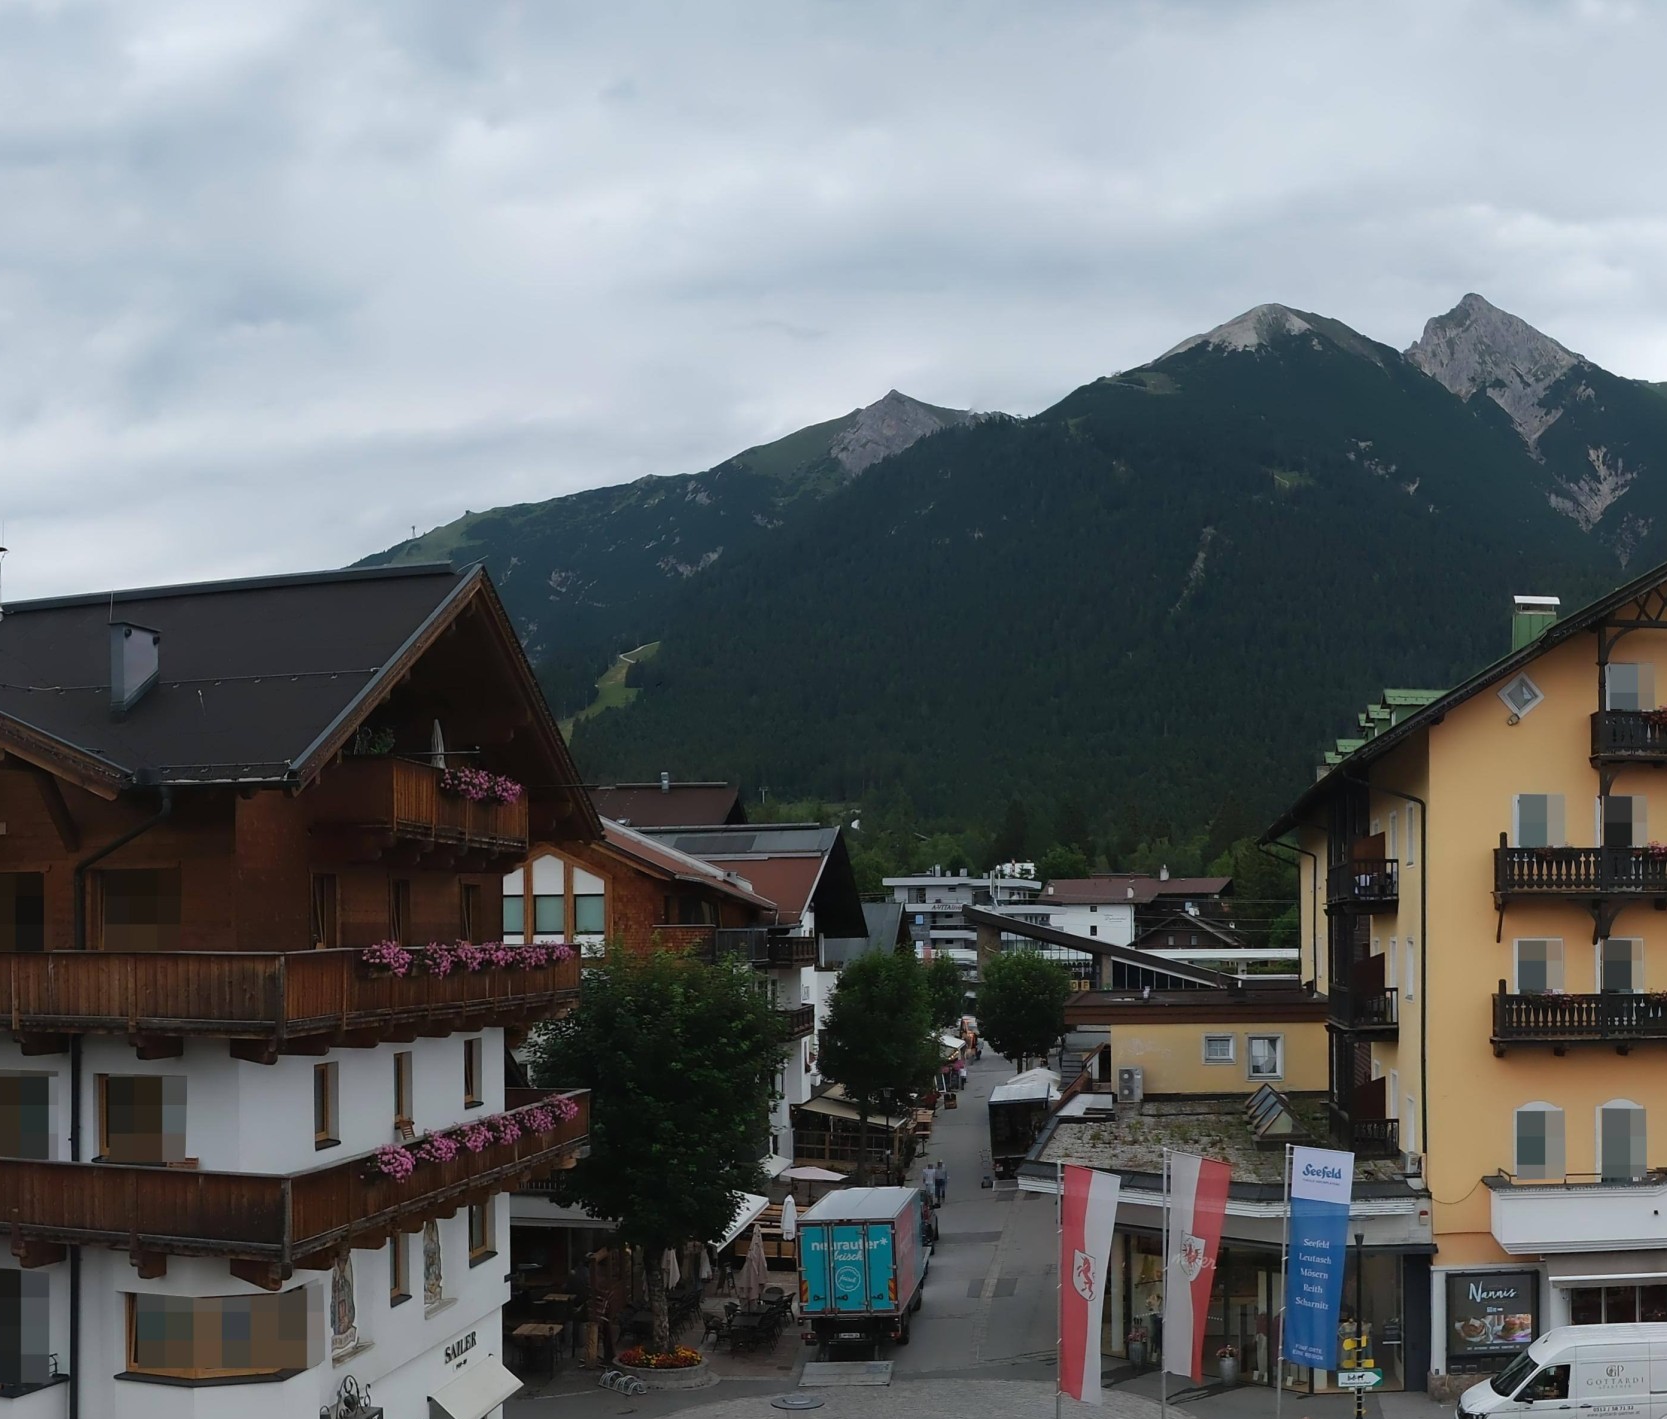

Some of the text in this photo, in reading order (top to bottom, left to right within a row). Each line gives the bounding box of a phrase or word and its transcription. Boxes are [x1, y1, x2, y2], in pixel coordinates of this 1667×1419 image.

[1302, 1163, 1342, 1179] Seefeld
[1303, 1238, 1330, 1249] Seefeld
[1299, 1252, 1332, 1265] Leutasch
[1300, 1267, 1329, 1280] Mösern
[1303, 1283, 1323, 1294] Reith
[1469, 1281, 1517, 1302] Nannis
[1295, 1296, 1329, 1310] Scharnitz
[444, 1331, 477, 1364] SAILER
[1587, 1377, 1644, 1385] GOTTARDI
